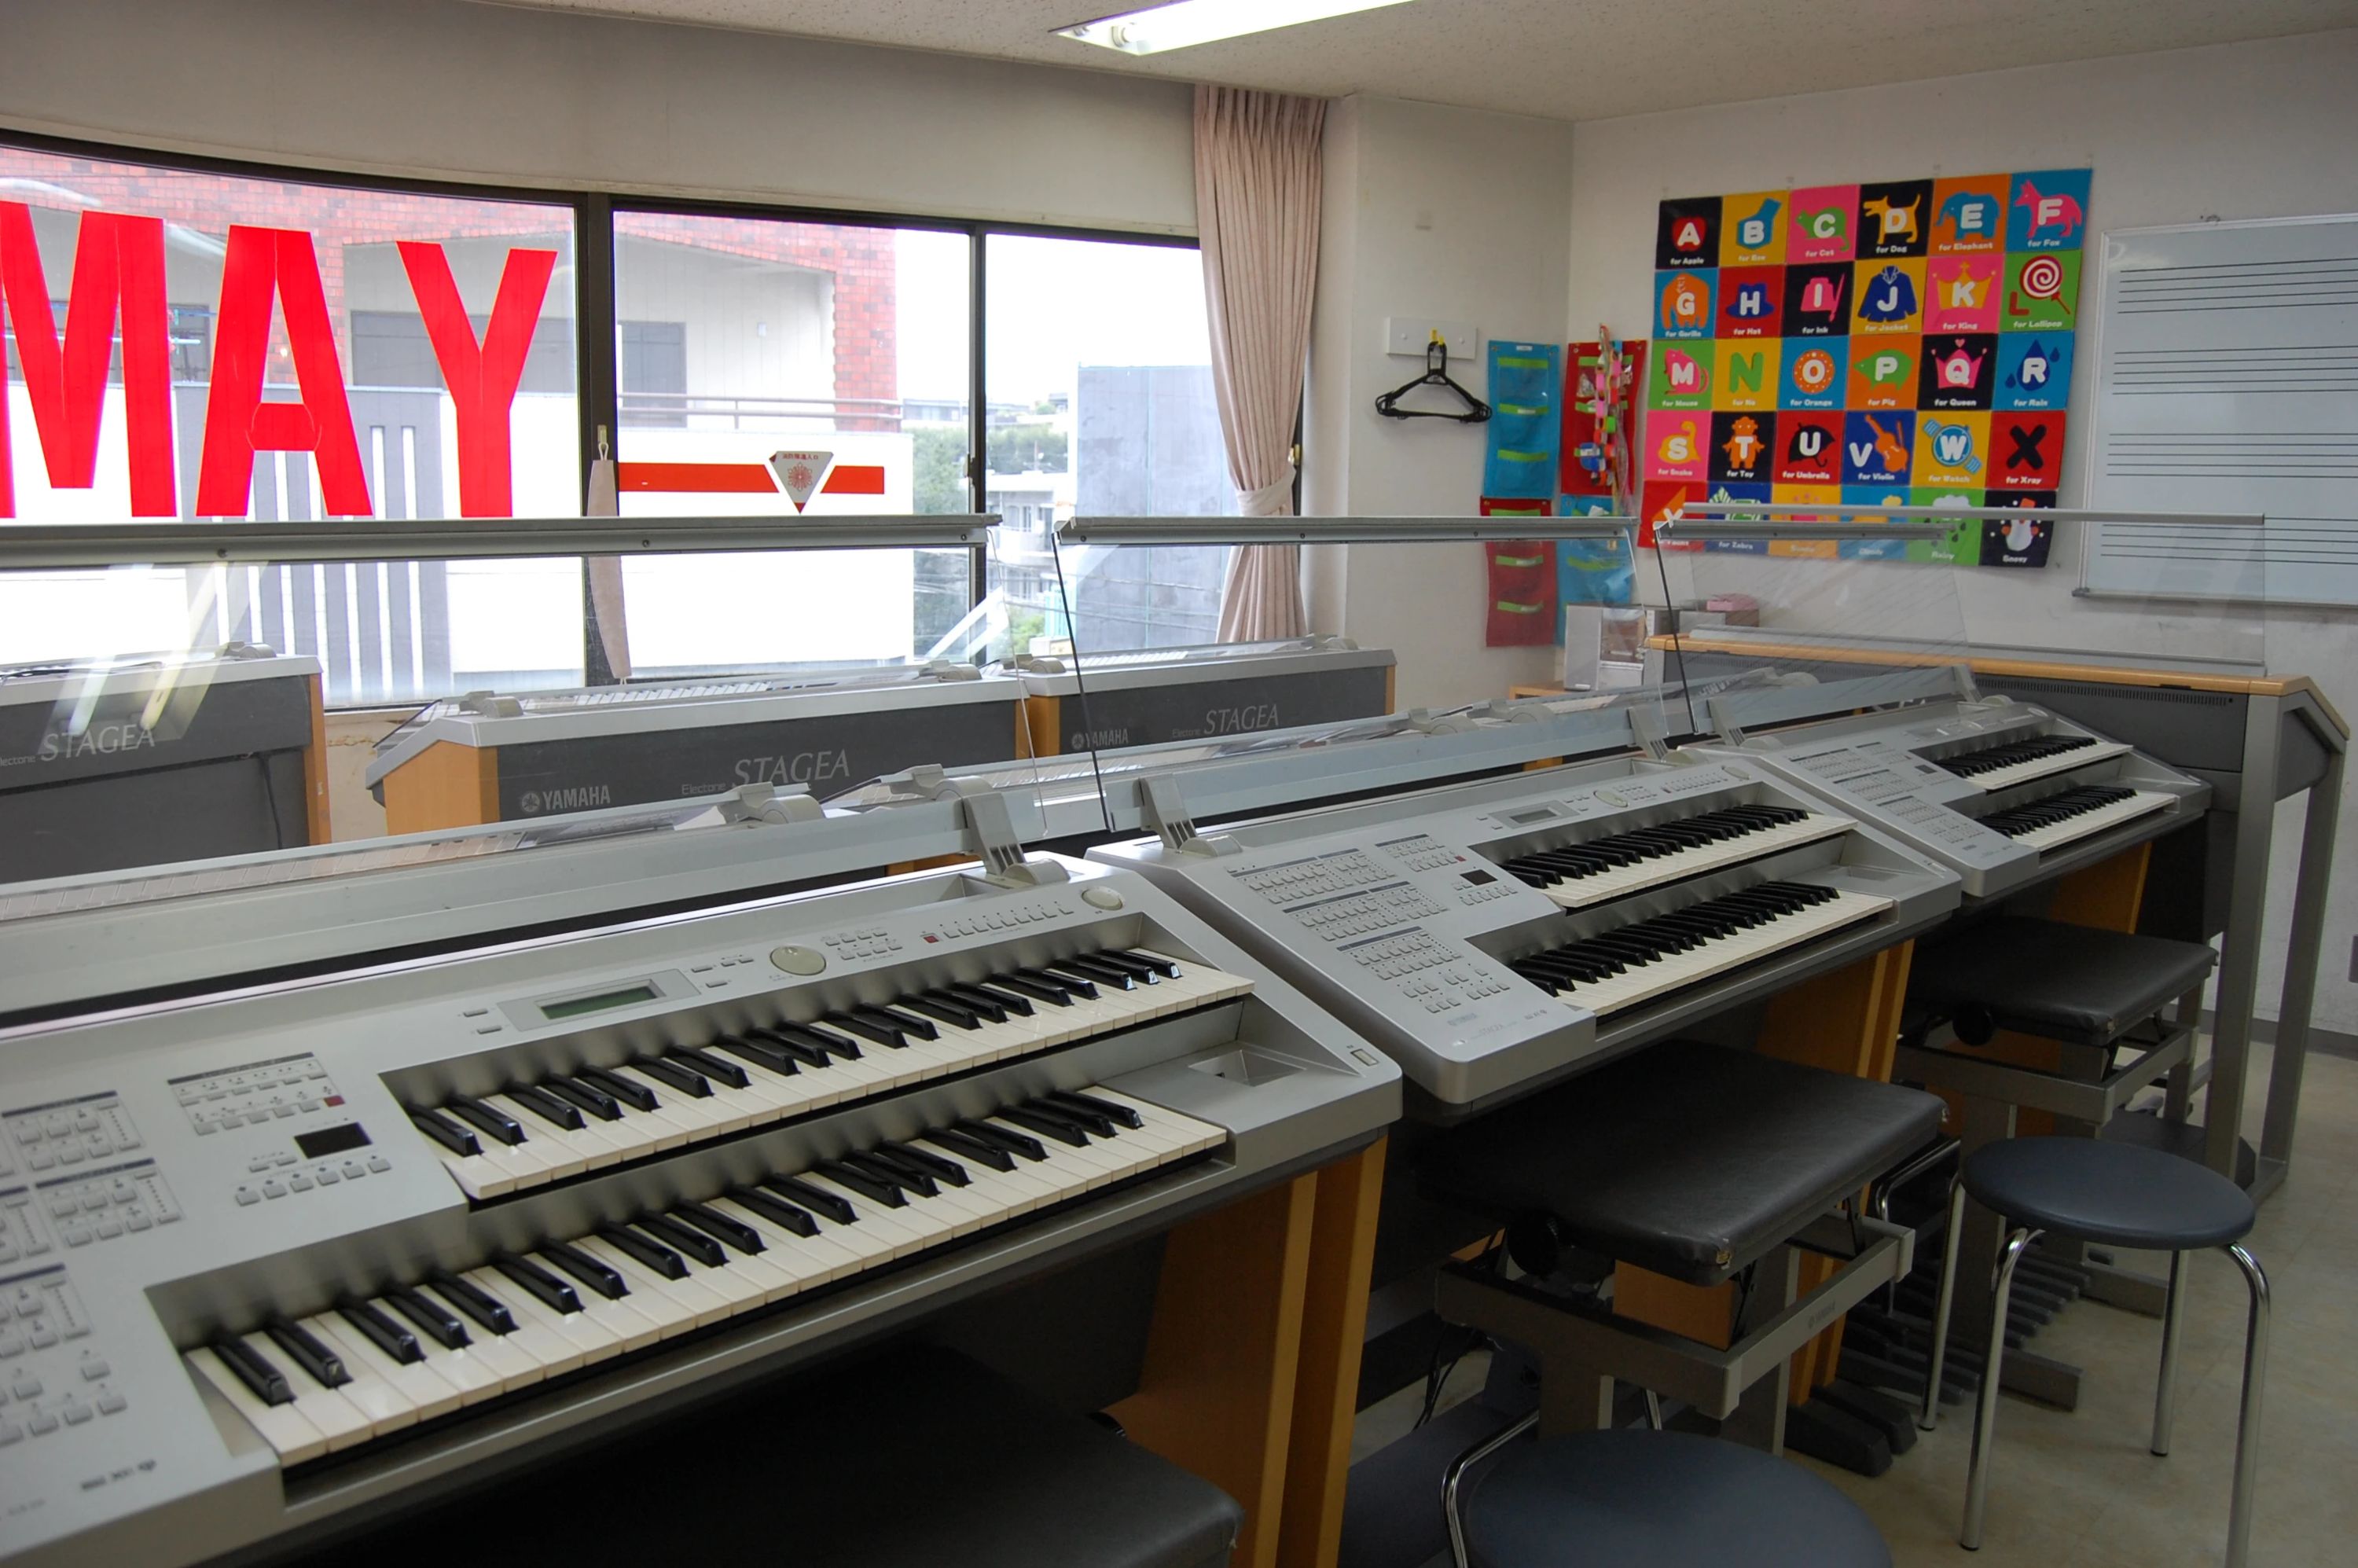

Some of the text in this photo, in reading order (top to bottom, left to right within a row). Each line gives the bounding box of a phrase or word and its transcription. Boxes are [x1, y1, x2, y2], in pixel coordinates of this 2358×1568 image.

[1885, 208, 1907, 233] D
[1960, 203, 1984, 229] E
[2038, 198, 2063, 226] F
[1677, 222, 1700, 246] A
[1743, 220, 1765, 244] B
[1813, 214, 1835, 238] C
[1953, 241, 1993, 251] Elephant
[1677, 292, 1695, 315] G
[1740, 291, 1760, 315] H
[1814, 284, 1823, 307] I
[1877, 286, 1898, 311] J
[1952, 281, 1975, 307] K
[2008, 292, 2029, 315] L
[1671, 362, 1694, 385] M
[1729, 352, 1764, 393] N
[1802, 359, 1825, 384] O
[1875, 356, 1898, 381] P
[1945, 358, 1970, 385] Q
[2022, 358, 2047, 384] R
[1668, 437, 1688, 460] S
[1735, 436, 1754, 459] T
[1799, 431, 1821, 457] U
[1849, 442, 1873, 468] V
[1940, 435, 1967, 461] W
[2006, 424, 2047, 469] X
[1872, 472, 1895, 481] Violin
[2020, 476, 2042, 485] Xray
[1203, 703, 1279, 735] STAGEA
[0, 723, 156, 767] lectone STAGEA
[542, 784, 612, 811] YAMAHA
[732, 749, 850, 788] STAGEA
